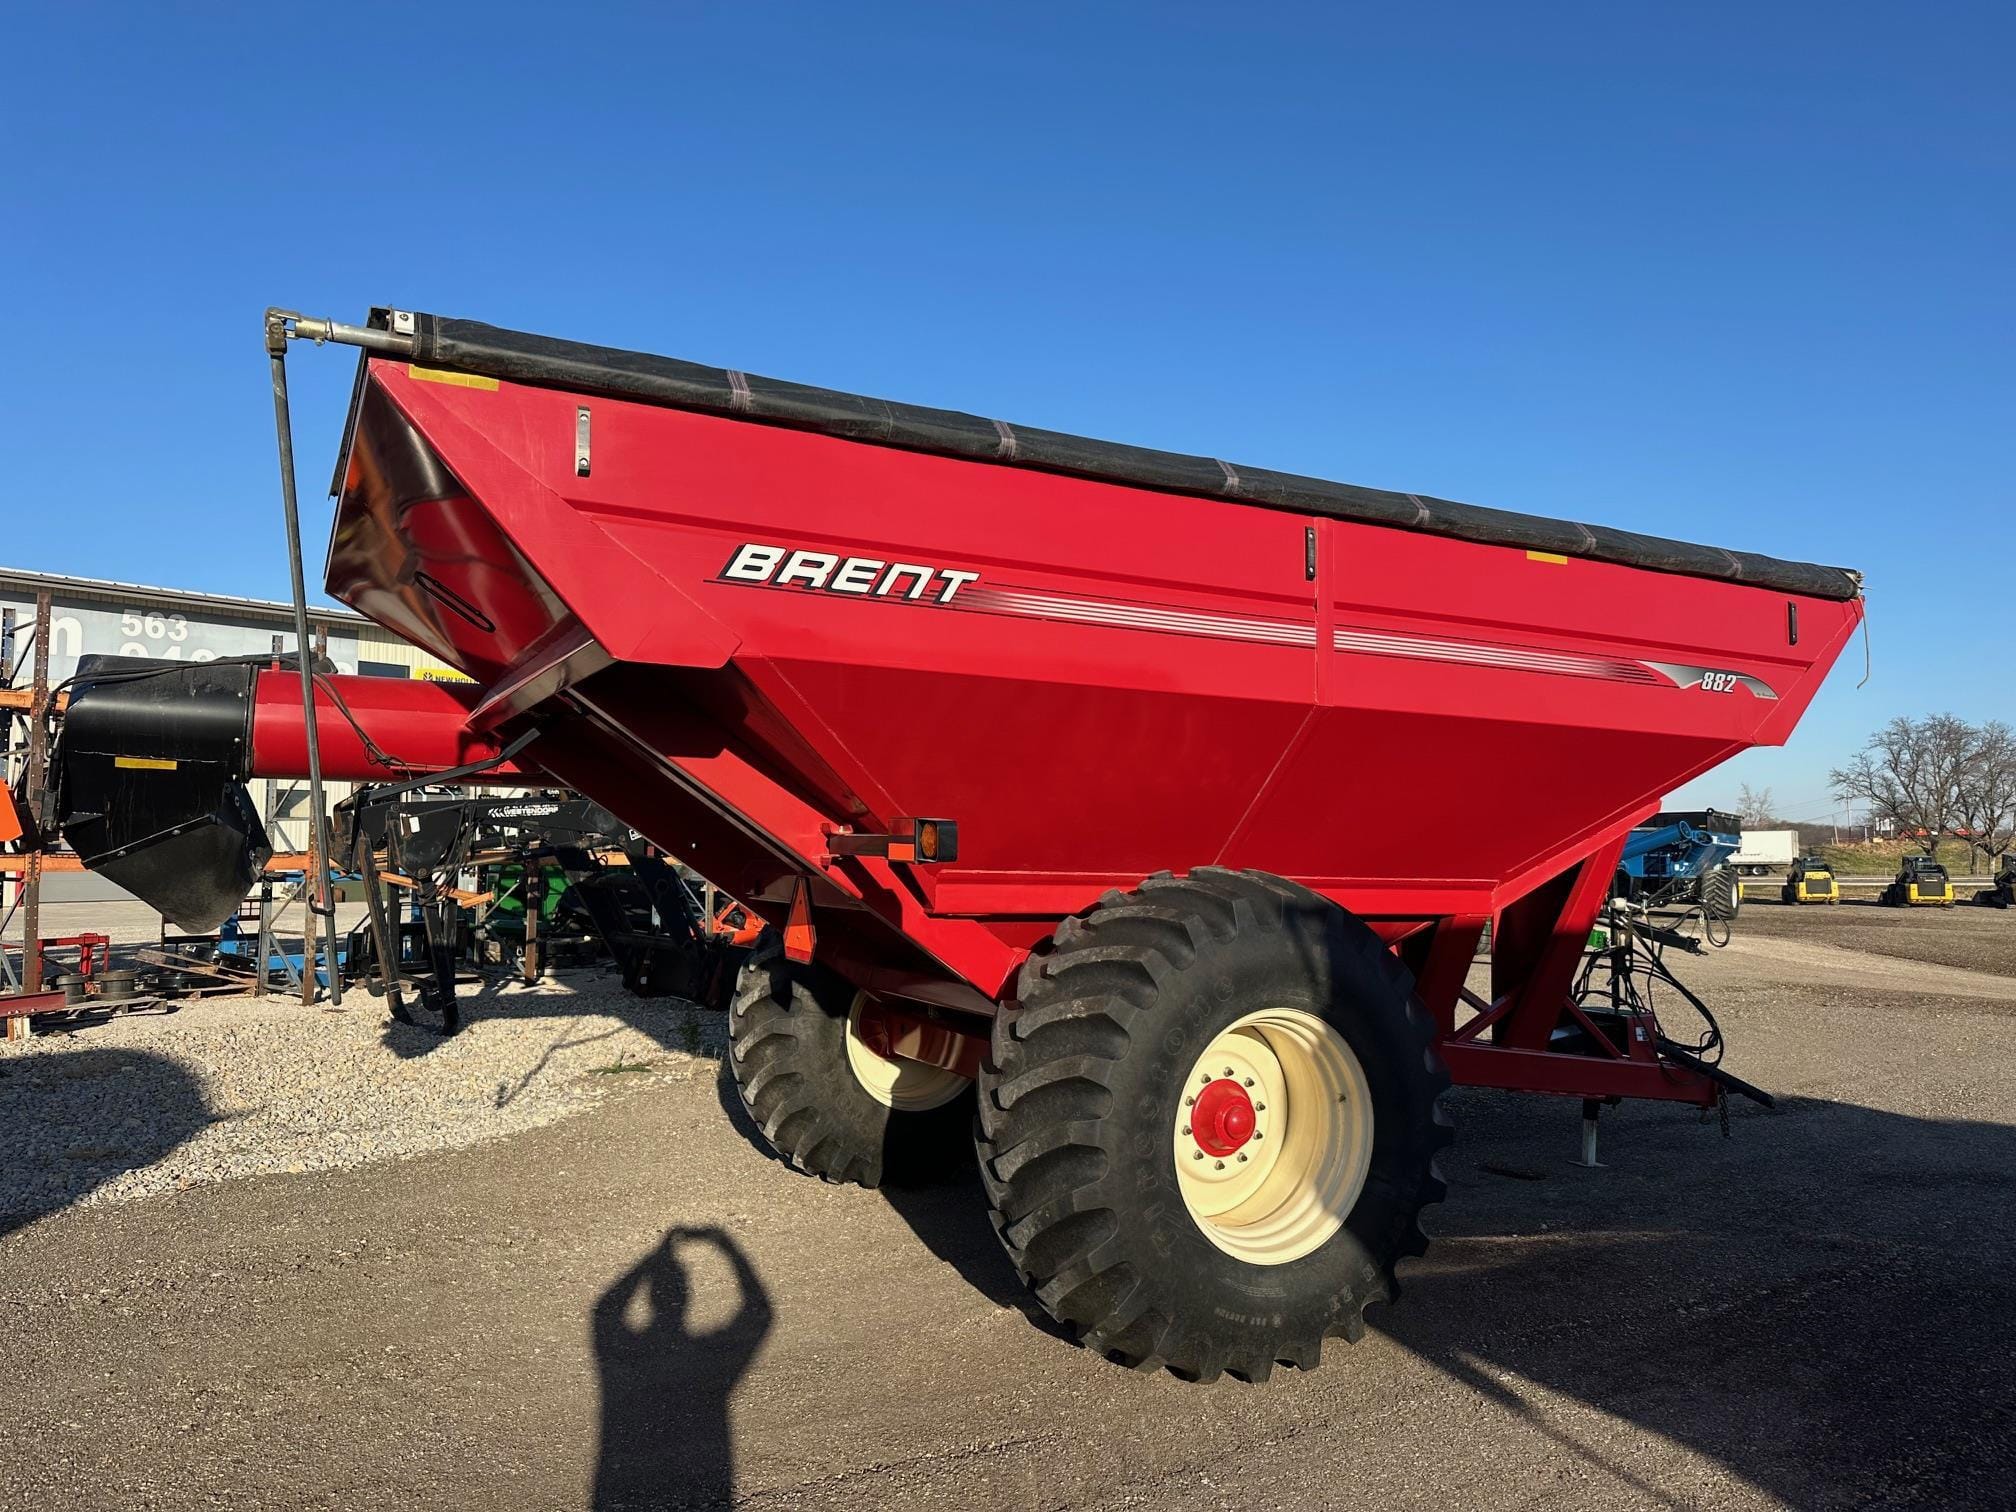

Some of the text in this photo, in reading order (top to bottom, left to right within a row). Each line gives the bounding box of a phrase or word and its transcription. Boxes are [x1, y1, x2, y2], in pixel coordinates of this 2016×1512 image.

[718, 543, 981, 604] BRENT
[121, 608, 188, 641] 563
[1701, 672, 1737, 693] 882
